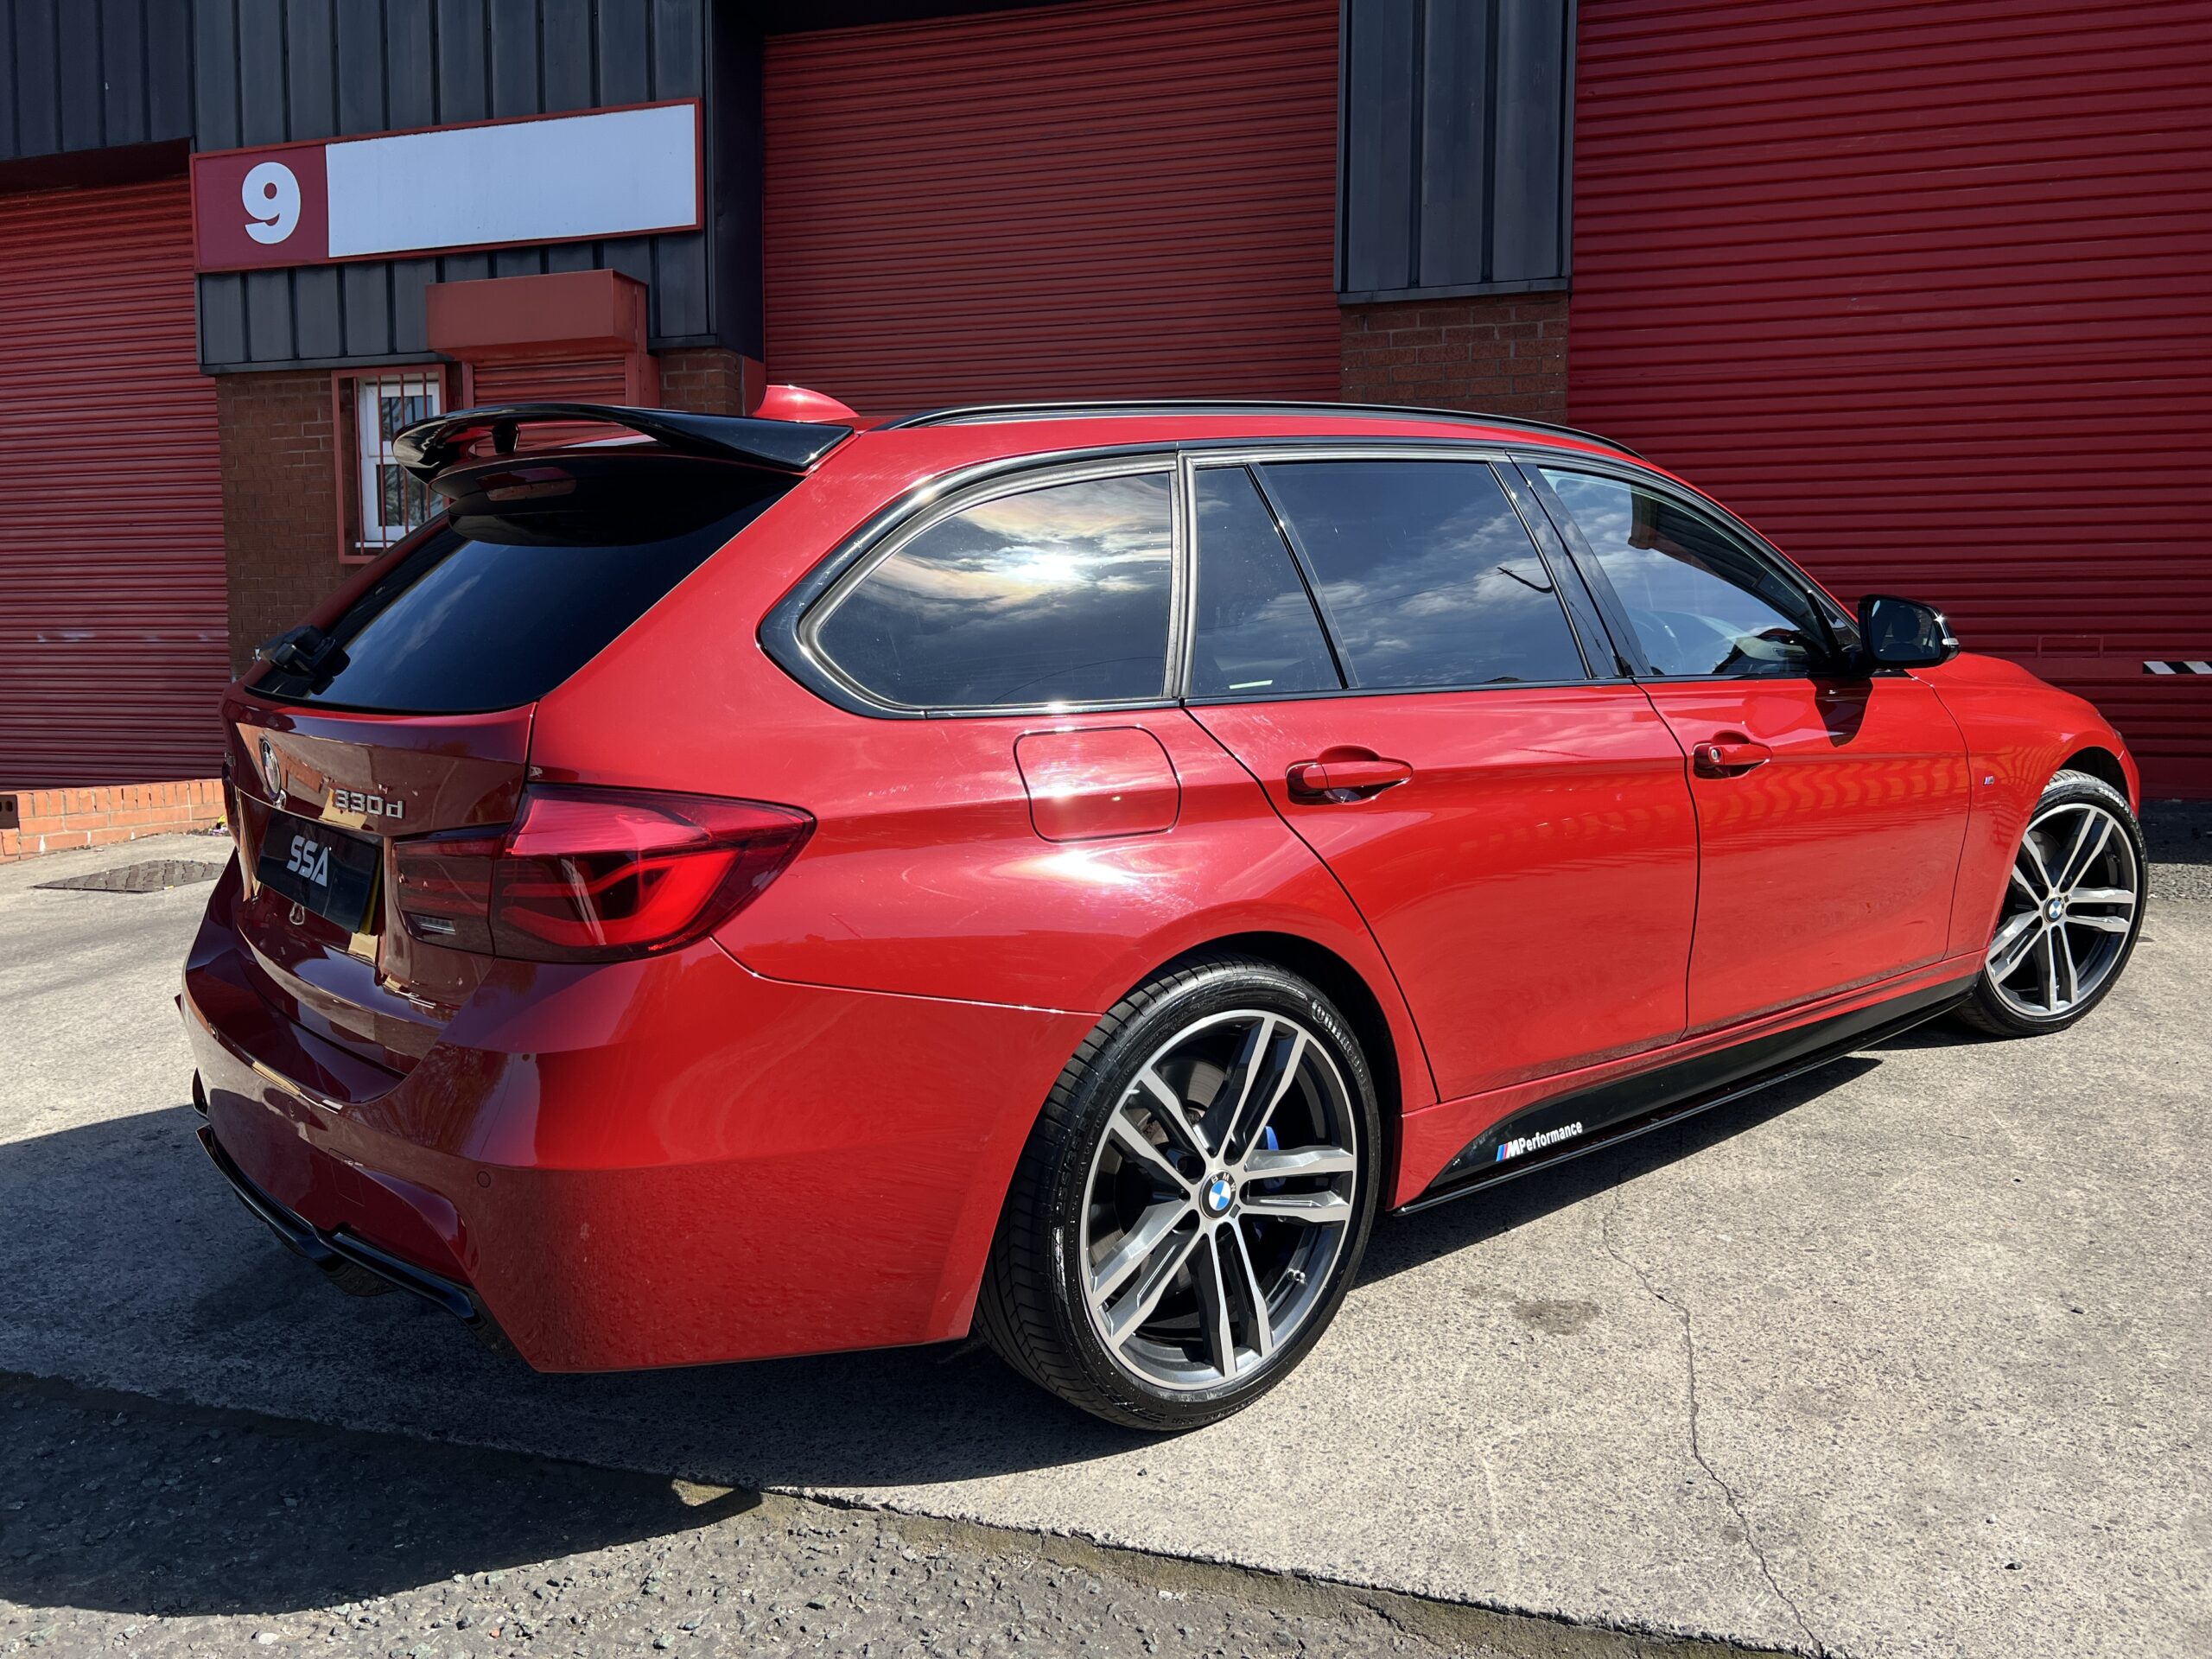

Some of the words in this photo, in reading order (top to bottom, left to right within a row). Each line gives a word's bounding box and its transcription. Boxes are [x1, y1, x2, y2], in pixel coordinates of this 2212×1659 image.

[241, 162, 302, 245] 9
[335, 789, 404, 819] 330d
[286, 835, 328, 887] SSA
[1211, 1173, 1236, 1192] BMW
